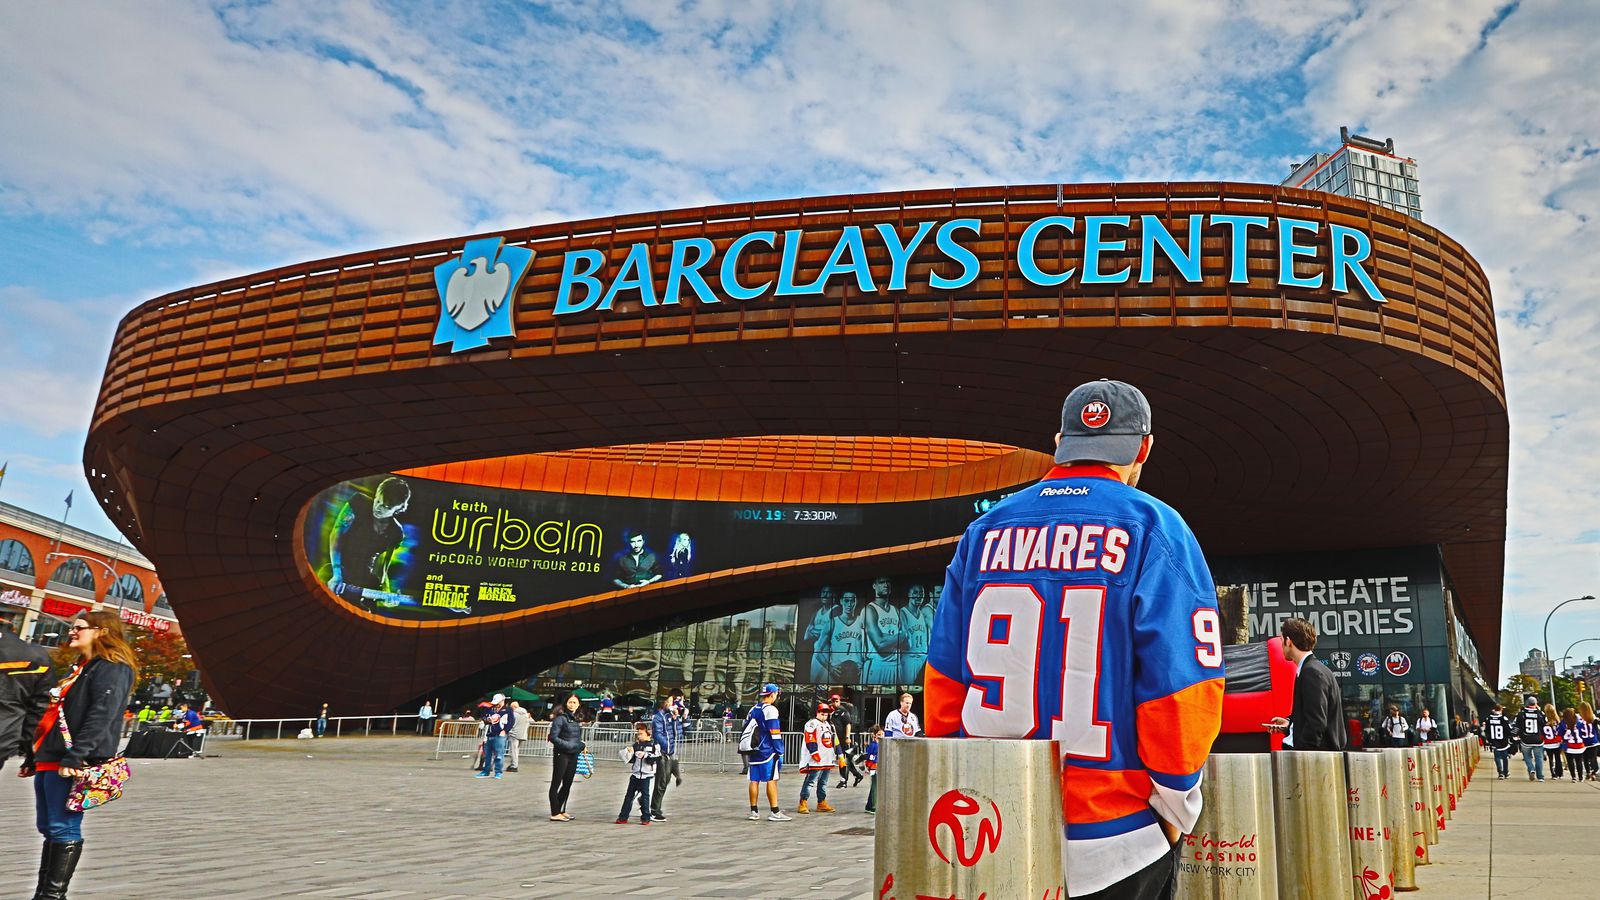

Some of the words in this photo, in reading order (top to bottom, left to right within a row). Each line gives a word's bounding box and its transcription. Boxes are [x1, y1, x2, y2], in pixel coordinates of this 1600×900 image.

[552, 217, 983, 316] BARCLAYS
[1016, 213, 1388, 304] CENTER
[1039, 486, 1090, 497] Reebok
[452, 499, 488, 513] keith
[431, 507, 603, 558] urban
[979, 524, 1130, 575] TAVARES
[570, 562, 601, 573] 2016
[426, 574, 443, 582] and
[425, 582, 470, 593] BRETT
[1289, 576, 1411, 606] CREATE
[422, 590, 470, 609] ELDREDGE
[846, 642, 852, 655] 7
[961, 583, 1112, 762] 91
[1490, 725, 1504, 740] 18
[1525, 718, 1538, 734] 91
[1349, 827, 1375, 841] INE
[1194, 851, 1257, 862] CASINO
[1181, 862, 1200, 874] NEW
[1203, 865, 1231, 877] YORK
[1235, 867, 1257, 877] CITY
